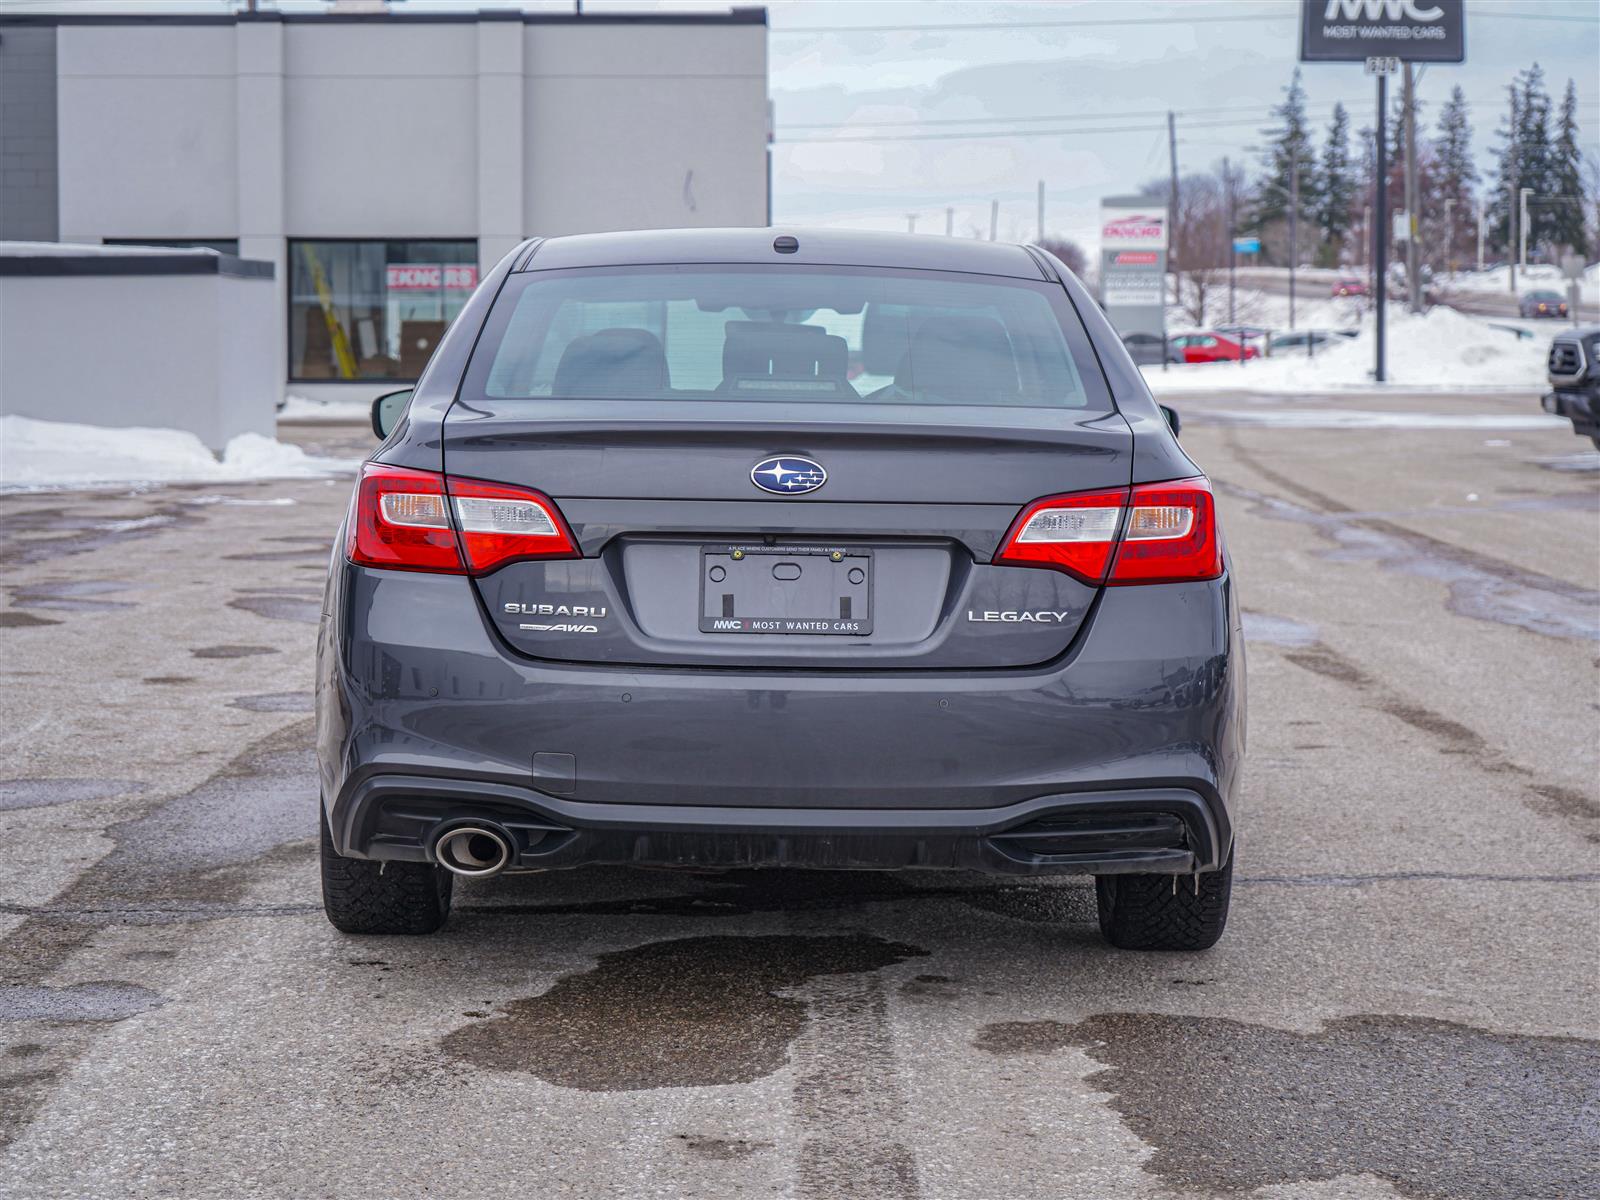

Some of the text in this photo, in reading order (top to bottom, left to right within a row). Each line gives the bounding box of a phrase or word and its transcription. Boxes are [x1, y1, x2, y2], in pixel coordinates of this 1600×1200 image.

[1323, 25, 1446, 39] MOST WANTED CARS
[504, 603, 606, 618] SUBARU
[968, 611, 1068, 622] LEGACY
[548, 624, 598, 633] AWD
[713, 620, 859, 630] MWC MOST WANTED CARS
